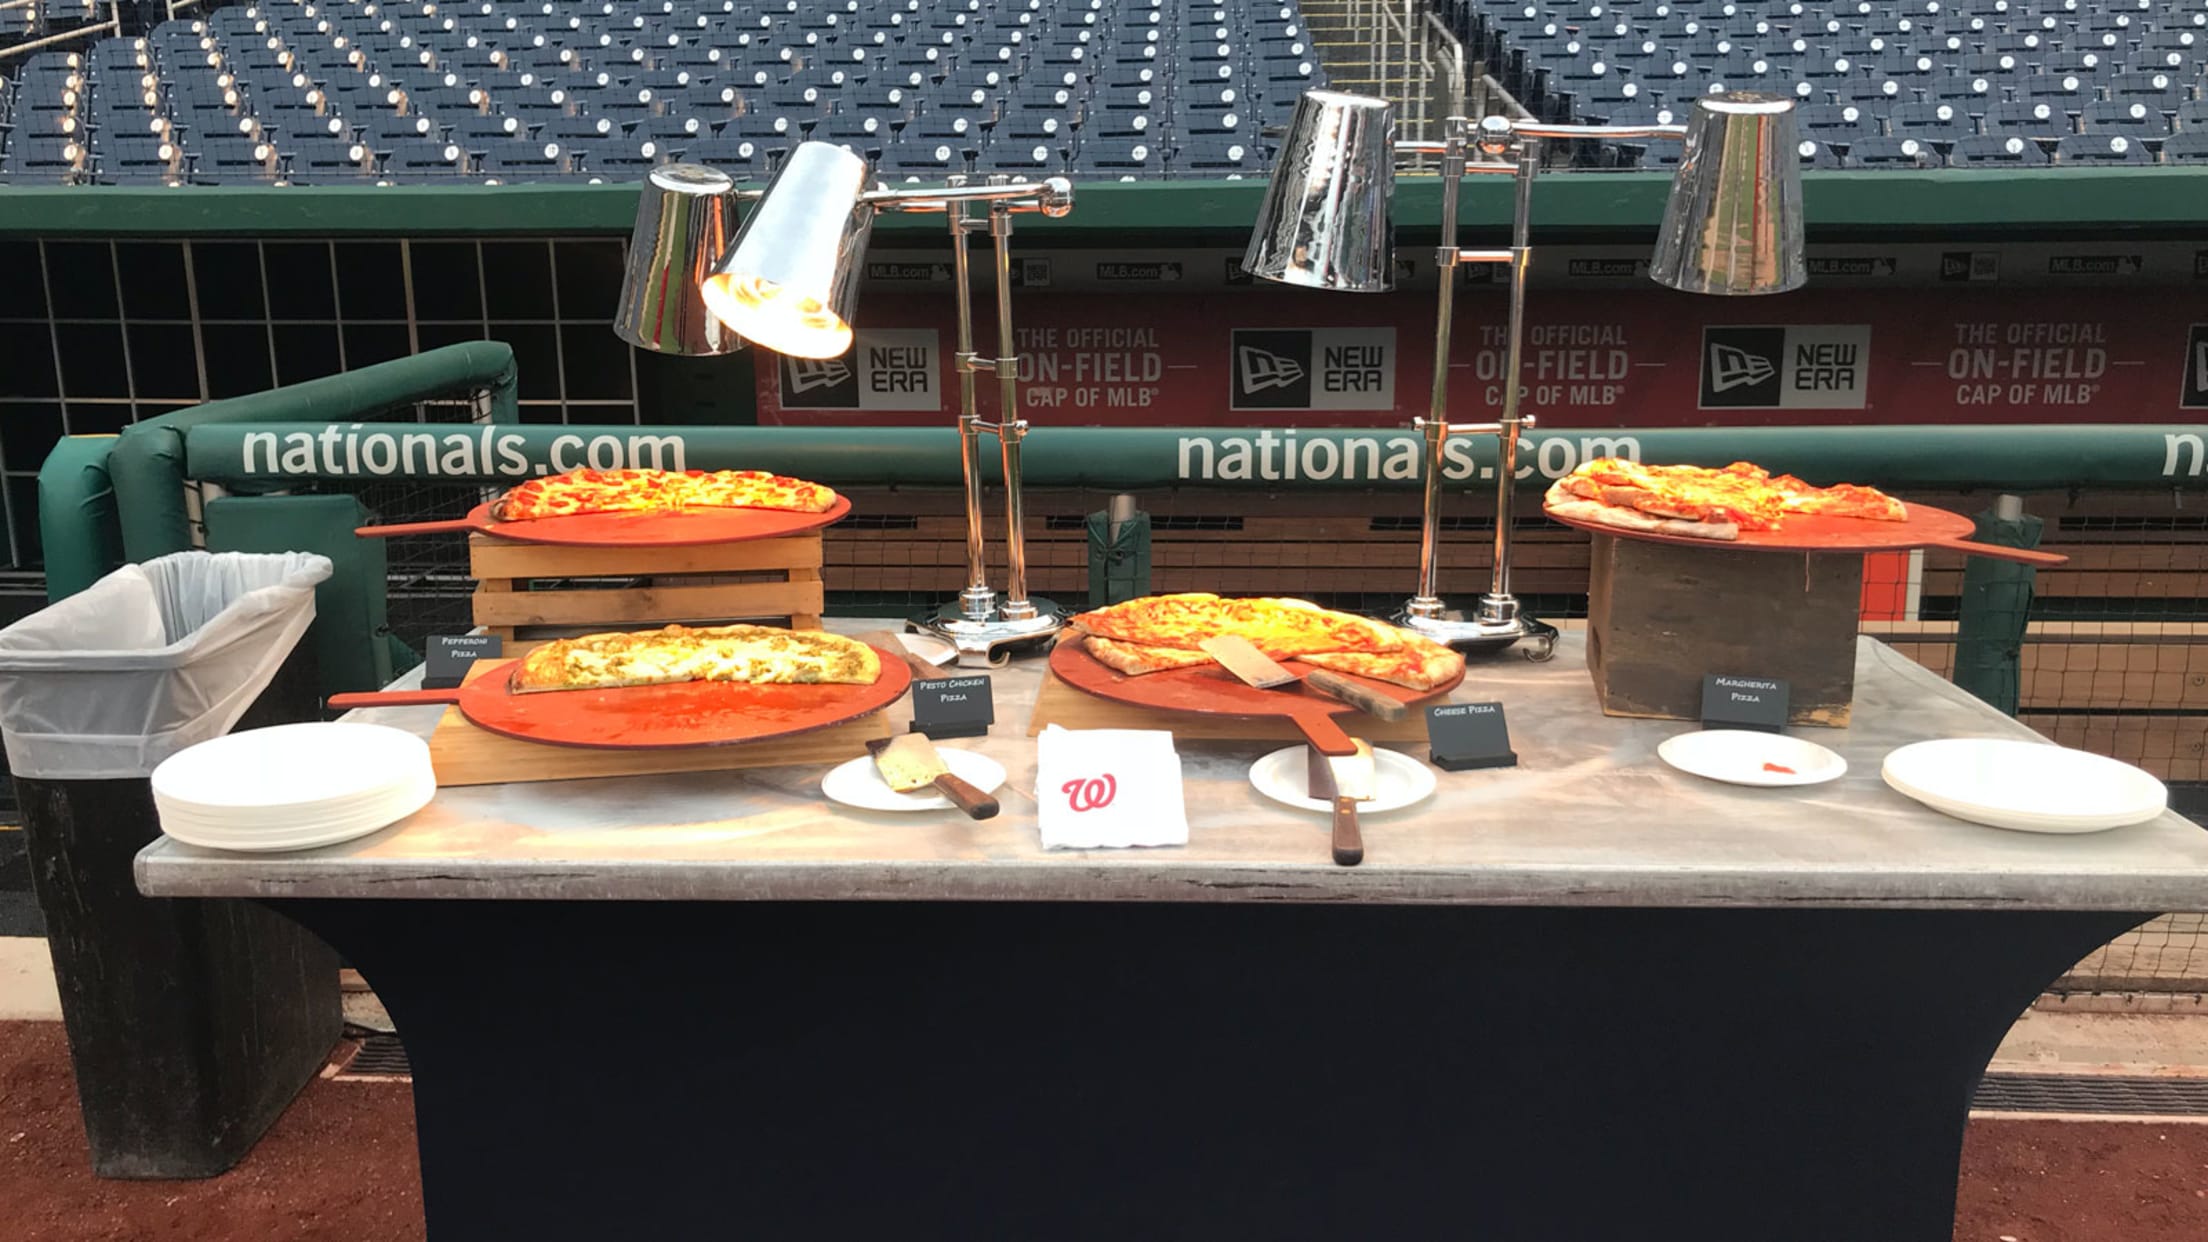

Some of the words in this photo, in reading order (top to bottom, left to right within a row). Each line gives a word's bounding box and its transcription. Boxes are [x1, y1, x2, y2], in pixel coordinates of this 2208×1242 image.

[1016, 327, 1058, 348] THE
[1066, 327, 1160, 348] OFFICIAL
[1479, 325, 1511, 345] TH
[1530, 324, 1628, 345] OFFICIAL
[1954, 323, 1999, 345] THE
[2006, 322, 2107, 345] OFFICIAL
[869, 346, 927, 369] NEW
[1324, 345, 1384, 369] NEW
[1796, 343, 1858, 367] NEW
[1947, 348, 2107, 380] ON-FIELD
[1017, 352, 1162, 382] ON-FIELD
[871, 370, 928, 393] ERA
[1324, 369, 1382, 392] ERA
[1795, 367, 1855, 391] ERA
[1026, 386, 1068, 407] CAP
[1075, 386, 1100, 407] OF
[1485, 385, 1529, 406] CP
[1535, 385, 1563, 405] OF
[1956, 384, 2002, 405] CAP
[2008, 384, 2037, 405] OF
[242, 422, 687, 477] nationals.com
[1177, 429, 1641, 481] nationas.com
